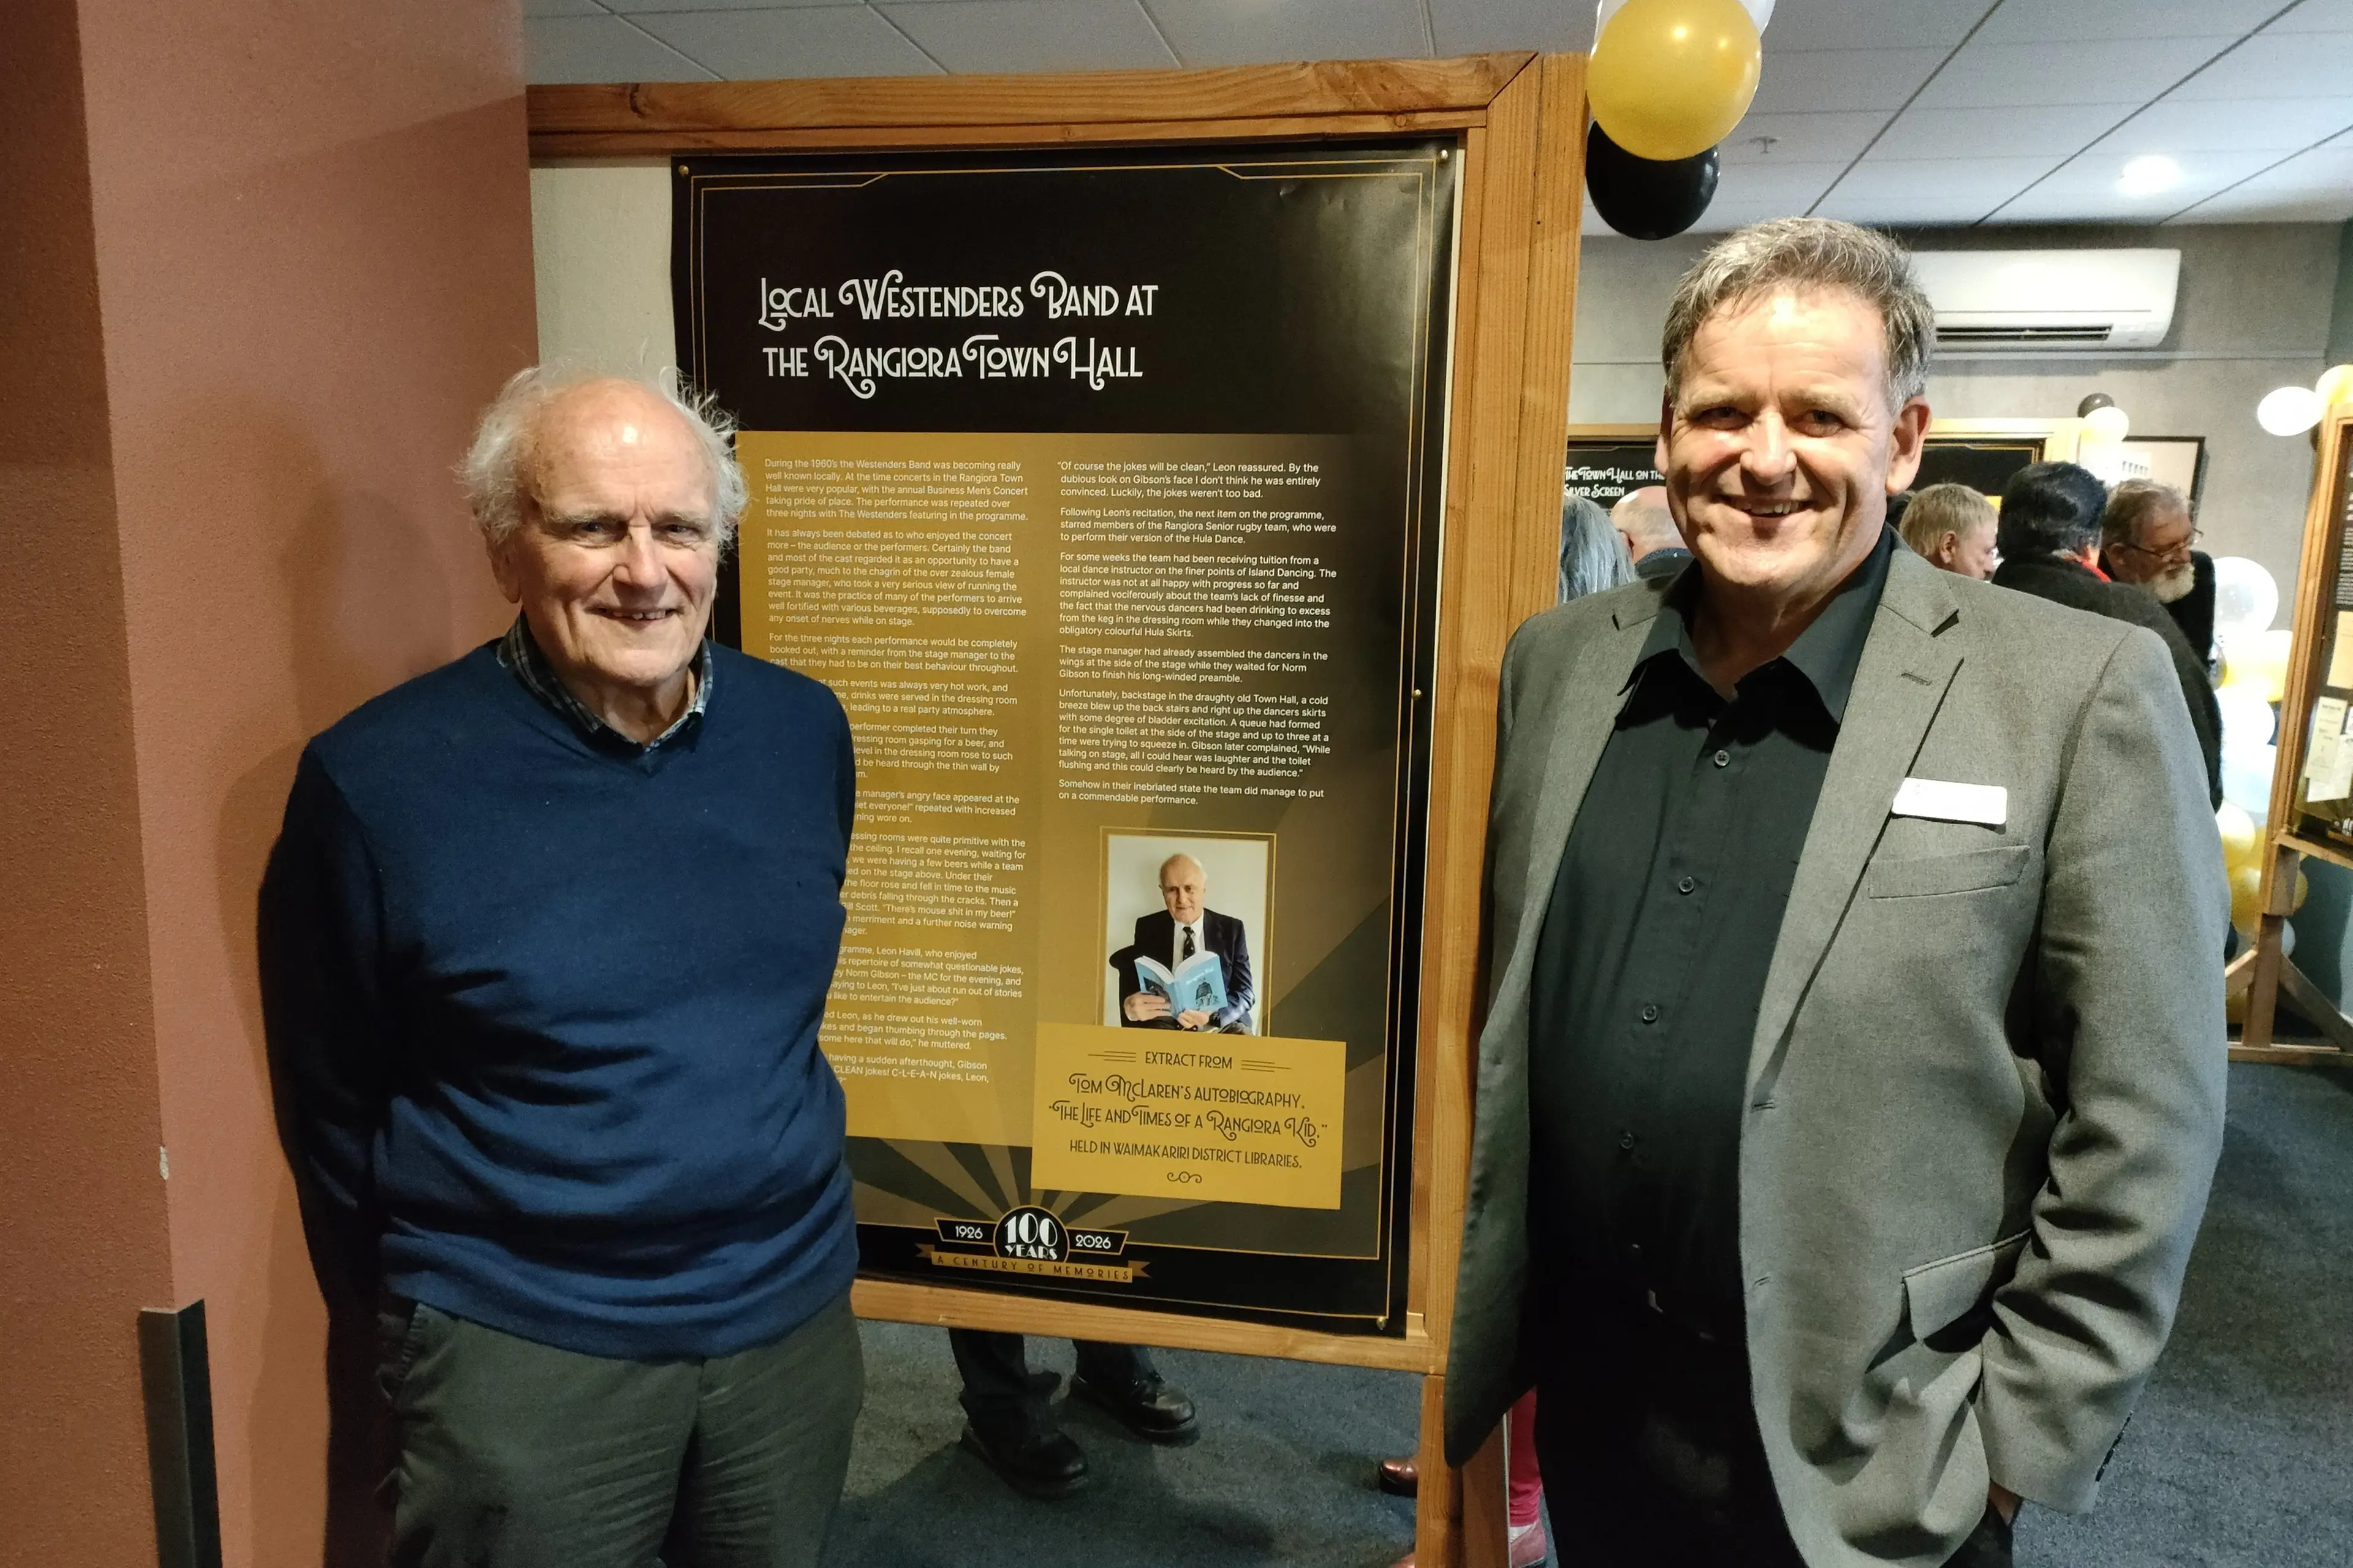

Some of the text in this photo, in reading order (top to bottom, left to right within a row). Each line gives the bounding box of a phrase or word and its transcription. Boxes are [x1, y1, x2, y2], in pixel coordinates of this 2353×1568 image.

[765, 458, 792, 469] During
[811, 459, 838, 468] 1960's
[855, 460, 906, 468] Westenders
[909, 460, 931, 469] Band
[953, 460, 995, 471] becoming
[997, 461, 1021, 471] really
[1123, 462, 1146, 472] jokes
[1149, 462, 1164, 471] will
[1180, 463, 1210, 472] clean,"
[1213, 463, 1235, 471] Leon
[1238, 463, 1286, 472] reassured.
[1289, 463, 1301, 474] By
[1303, 463, 1319, 472] the
[784, 471, 812, 480] known
[814, 472, 843, 482] locally.
[844, 472, 854, 480] At
[873, 472, 891, 481] time
[933, 472, 941, 481] in
[942, 473, 957, 482] the
[959, 473, 997, 483] Rangiora
[999, 473, 1023, 482] Town
[1061, 474, 1096, 483] dubious
[1133, 474, 1171, 483] Gibson's
[1173, 475, 1193, 484] face
[1200, 475, 1223, 484] don't
[1226, 475, 1248, 484] think
[1251, 475, 1262, 485] he
[1286, 476, 1320, 487] entirely
[1578, 466, 1606, 480] TOWN
[1606, 468, 1634, 483] HALL
[1635, 470, 1648, 480] ON
[1060, 487, 1263, 499] convinced. Luckily, the jokes weren't too bad.
[1591, 484, 1625, 498] SCREEN
[1061, 507, 1101, 518] Following
[1103, 508, 1130, 517] Leon's
[1132, 508, 1176, 518] recitation,
[1178, 509, 1193, 517] the
[1217, 509, 1237, 518] item
[1252, 509, 1267, 518] the
[1270, 511, 1324, 521] programme,
[1136, 520, 1145, 529] of
[1147, 521, 1162, 529] the
[1164, 521, 1203, 532] Rangiora
[1205, 521, 1234, 530] Senior
[1236, 522, 1262, 532] rugby
[1264, 523, 1289, 532] team,
[1292, 523, 1311, 531] who
[1071, 532, 1105, 542] perform
[1130, 533, 1162, 542] version
[1164, 533, 1173, 542] of
[1175, 534, 1190, 542] the
[1192, 534, 1212, 543] Hula
[1214, 534, 1245, 543] Dance.
[769, 632, 782, 641] For
[824, 635, 850, 645] nights
[874, 635, 928, 645] performance
[930, 637, 955, 646] would
[958, 637, 969, 646] be
[971, 639, 1018, 650] completely
[1059, 779, 1100, 788] Somehow
[1134, 782, 1176, 792] inebriated
[1219, 786, 1242, 794] team
[1244, 786, 1258, 795] did
[1260, 789, 1295, 798] manage
[1309, 789, 1324, 798] put
[1078, 793, 1139, 802] commendable
[1140, 794, 1198, 804] performance.
[828, 1053, 857, 1065] having
[866, 1056, 897, 1064] sudden
[899, 1056, 955, 1069] afterthought,
[957, 1060, 987, 1069] Gibson
[1146, 1051, 1232, 1069] EXTRACT FROM
[833, 1065, 989, 1083] CLEAN jokes! C-L-E-A-N jokes, Leon,
[1195, 1115, 1203, 1128] A
[1070, 1140, 1302, 1168] HELD IN WAIMAKARIRI DISTRICT LIBRARIES.
[955, 1225, 983, 1239] 1926
[1005, 1213, 1058, 1246] 100
[1075, 1234, 1111, 1249] 2026
[1005, 1244, 1058, 1260] YEARS
[953, 1257, 1017, 1270] CENTURY
[1028, 1263, 1043, 1273] OF
[1054, 1265, 1128, 1280] MEMORIES
